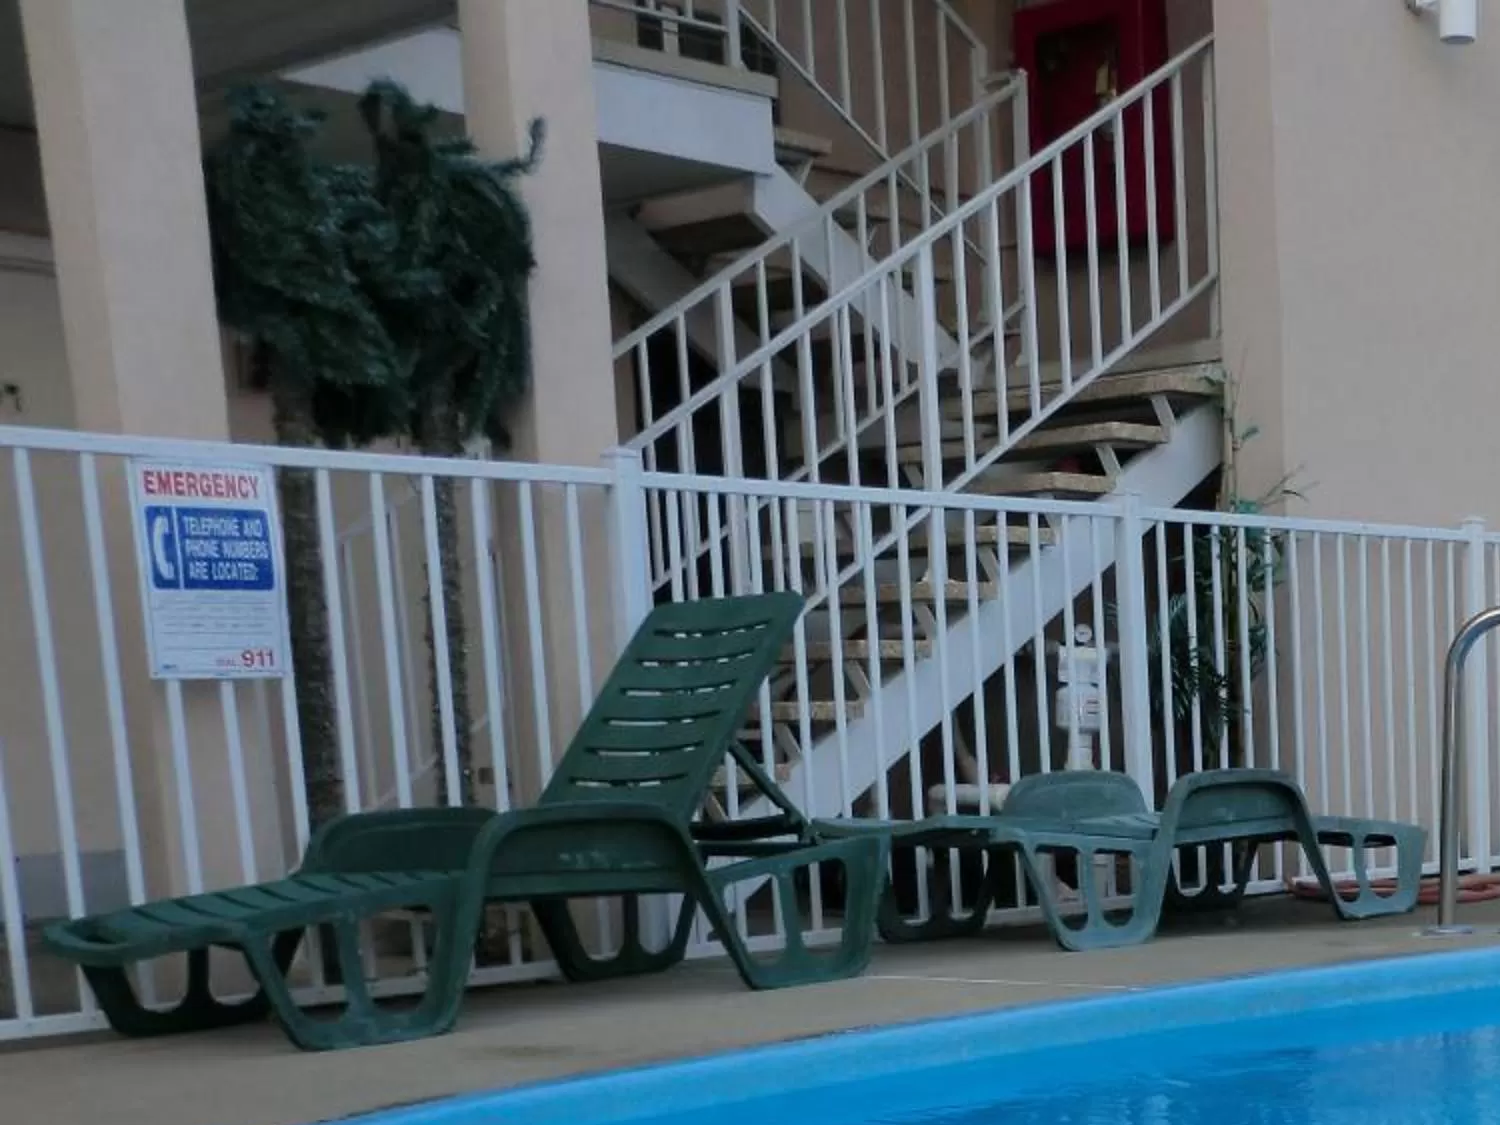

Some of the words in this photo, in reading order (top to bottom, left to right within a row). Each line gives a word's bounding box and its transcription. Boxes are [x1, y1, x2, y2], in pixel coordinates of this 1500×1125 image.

[142, 470, 259, 498] EMERGENCY
[182, 516, 241, 537] TELEPHONE
[188, 561, 209, 579] ARE
[241, 649, 274, 667] 911
